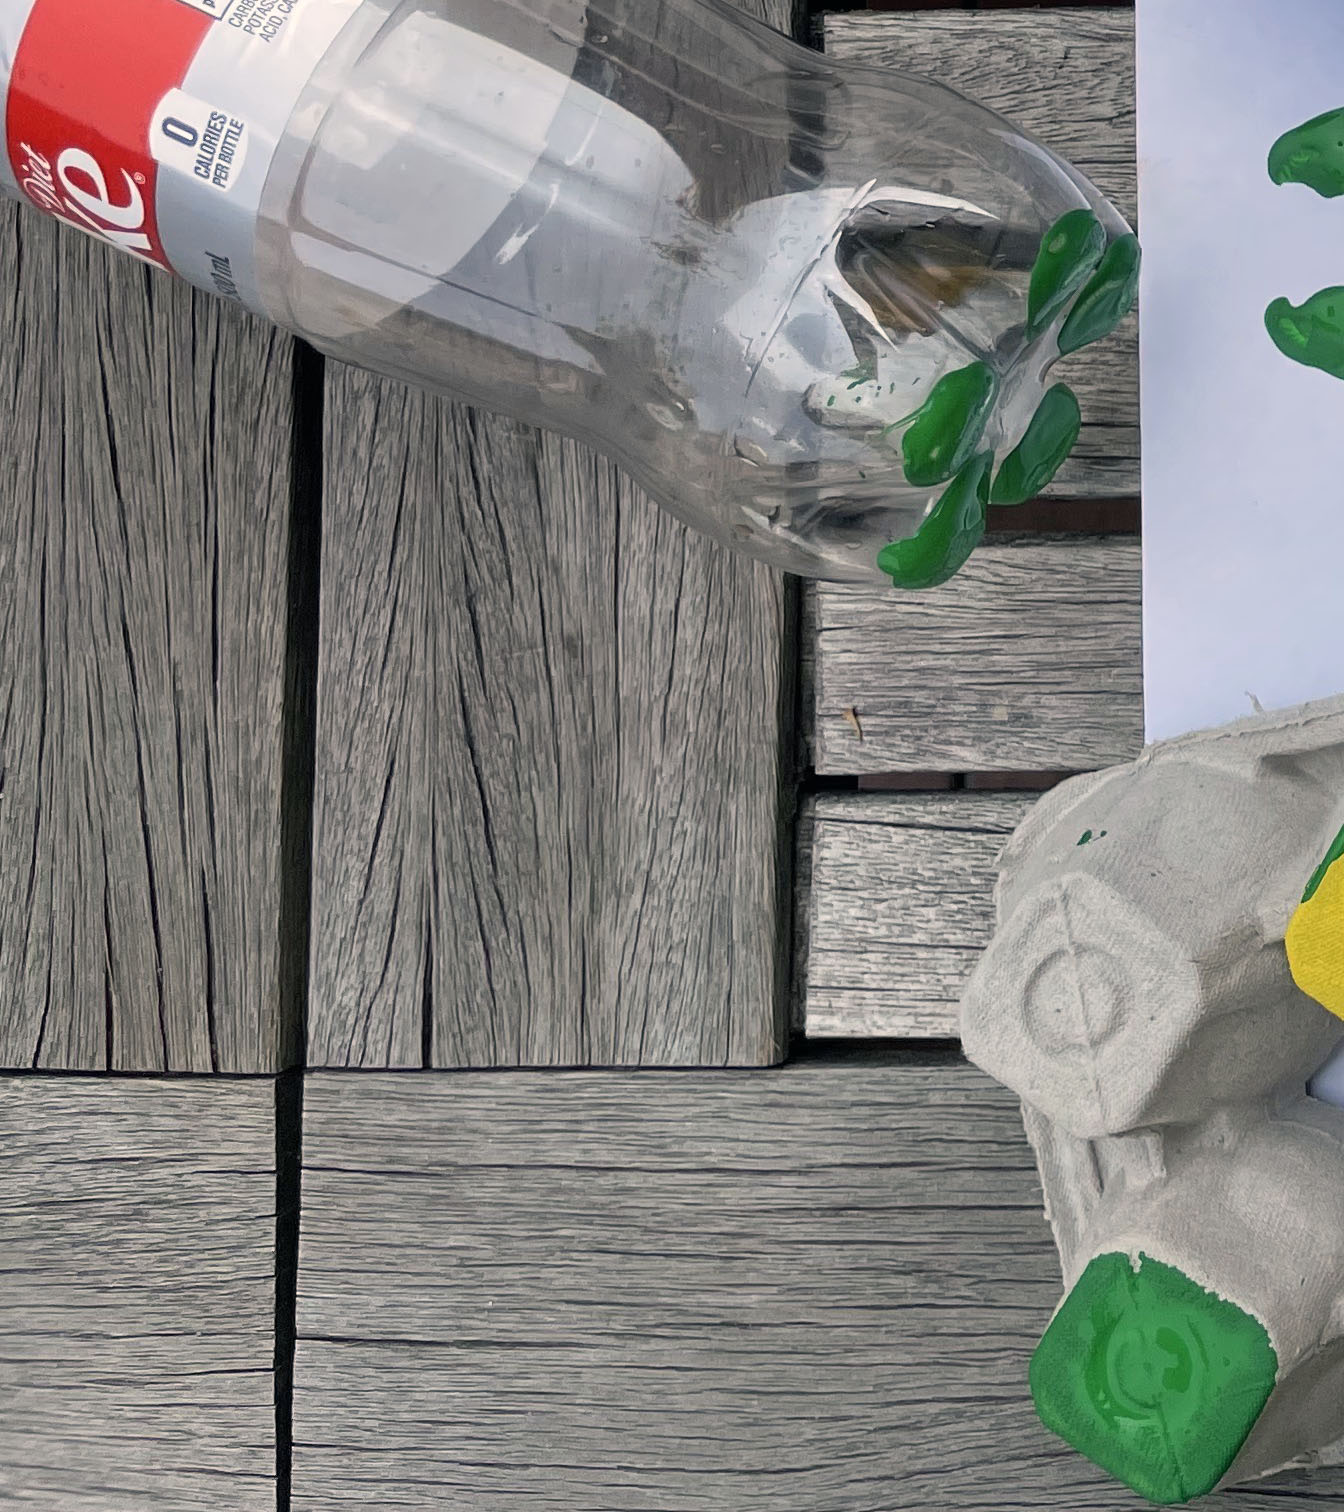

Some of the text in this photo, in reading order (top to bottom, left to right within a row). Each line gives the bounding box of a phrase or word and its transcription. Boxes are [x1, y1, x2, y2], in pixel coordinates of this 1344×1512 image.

[259, 15, 288, 44] ACID,
[162, 116, 199, 148] 0
[194, 111, 228, 180] CALORIES
[212, 118, 245, 189] PER BOTTLE
[20, 141, 65, 214] Diet
